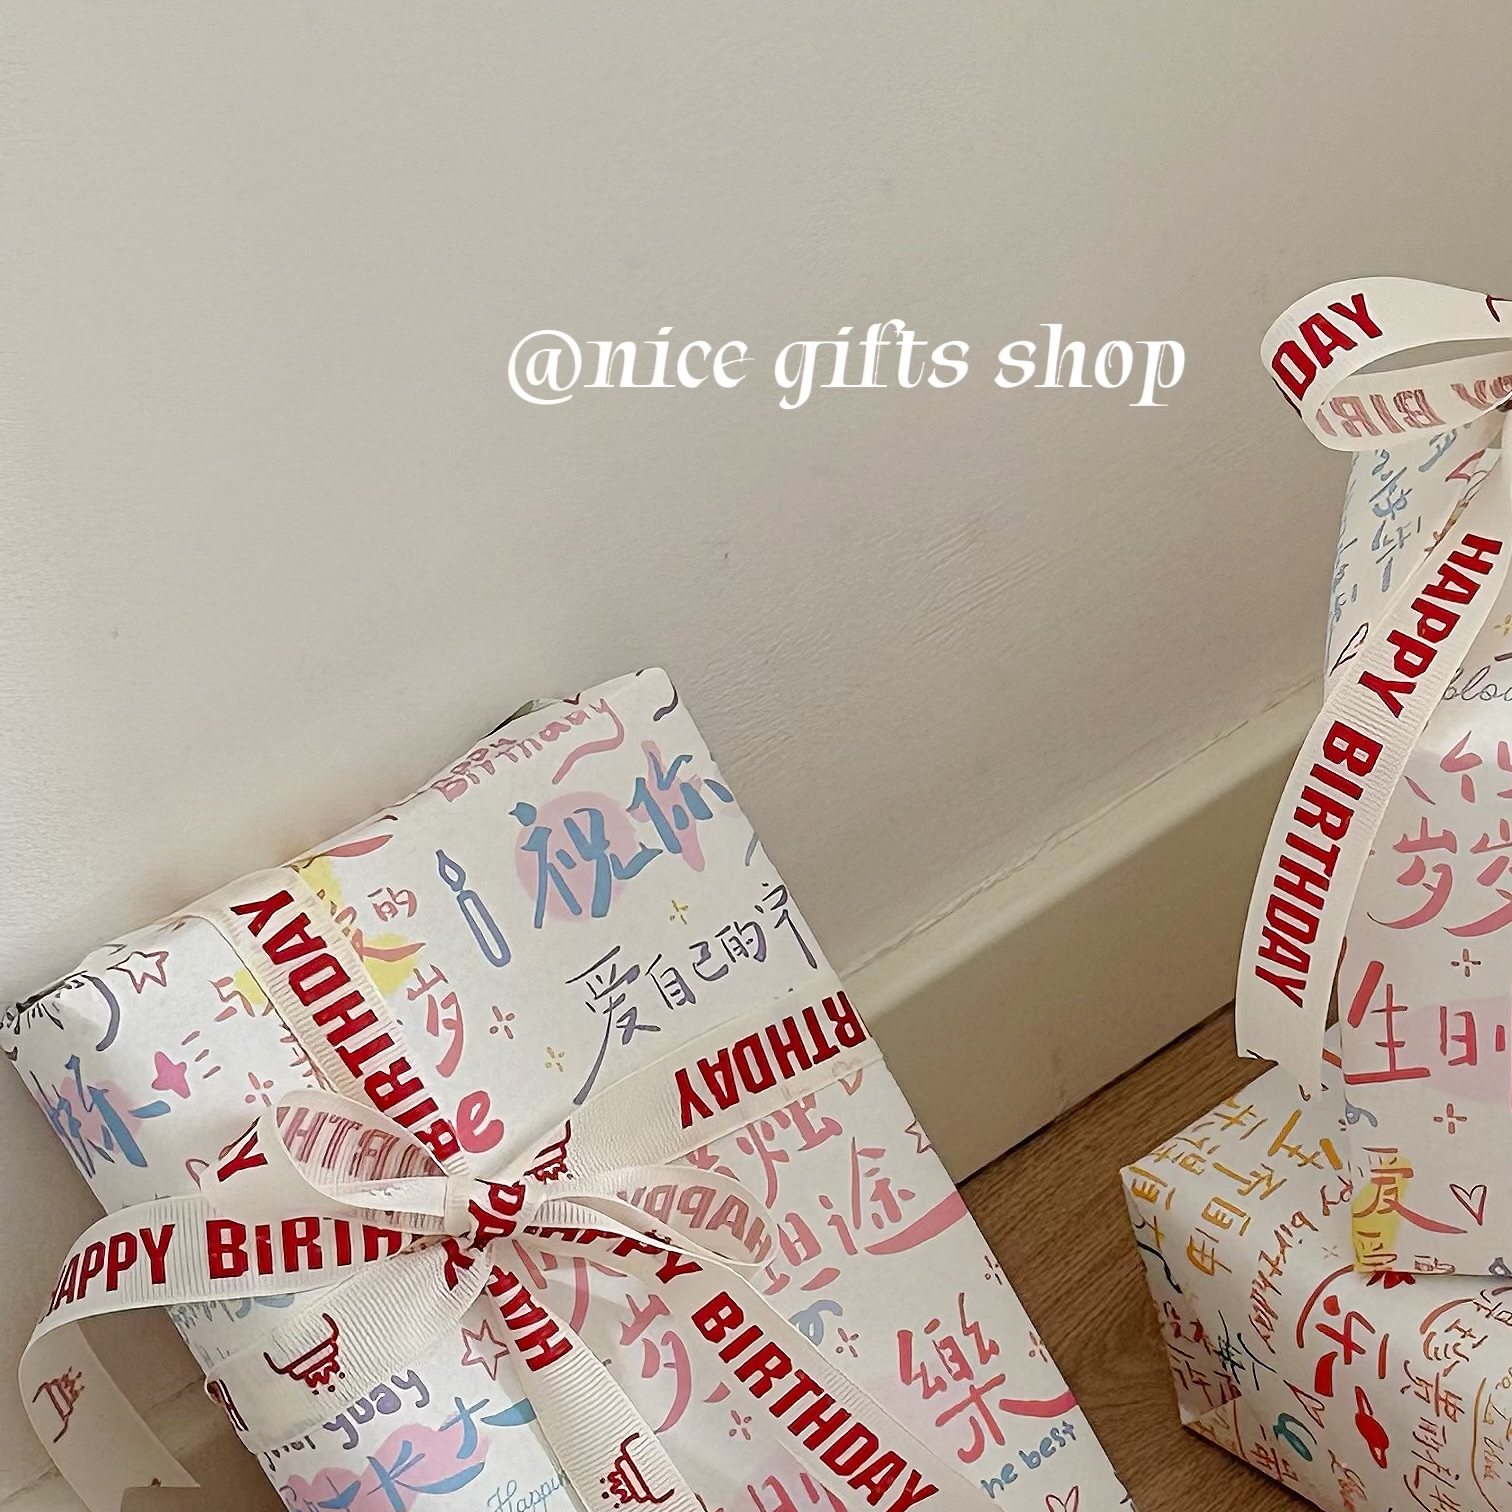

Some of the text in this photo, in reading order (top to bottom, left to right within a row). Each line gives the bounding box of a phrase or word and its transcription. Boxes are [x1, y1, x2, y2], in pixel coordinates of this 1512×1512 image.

[1358, 532, 1504, 720] HAPPY
[1254, 720, 1385, 1008] BIRTHDAY
[672, 990, 873, 1130] RTHDAY
[206, 1214, 410, 1279] BIRTH
[980, 1421, 1078, 1500] he best
